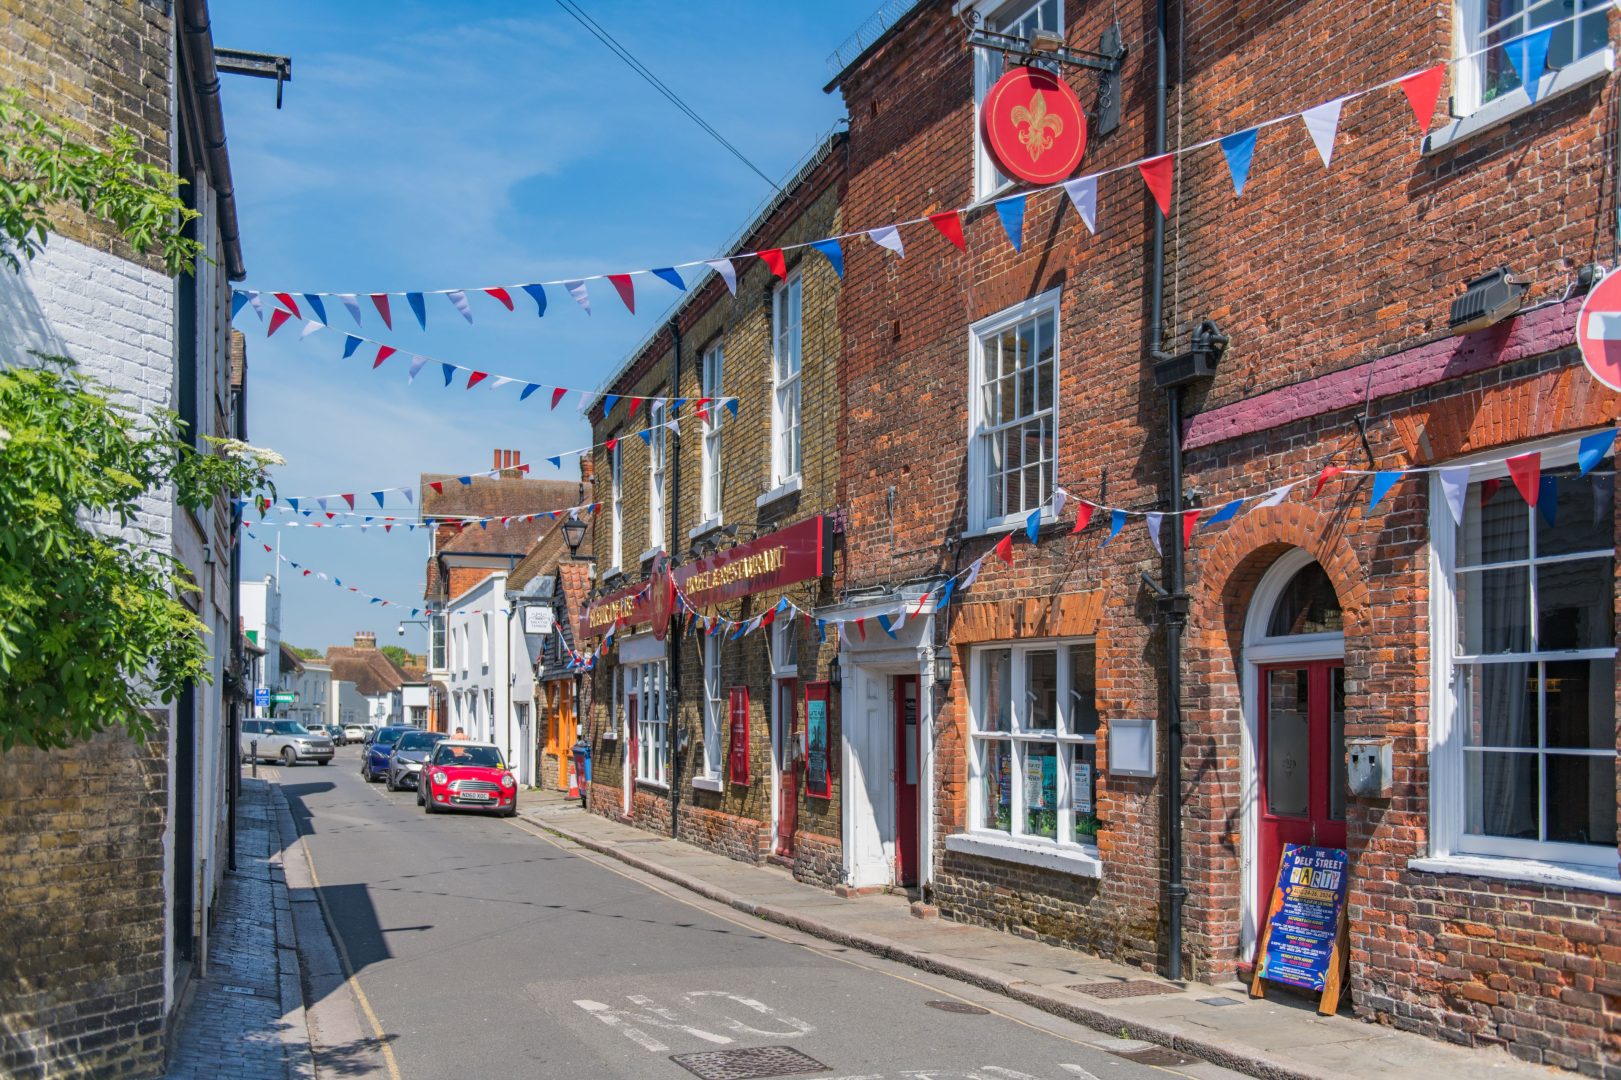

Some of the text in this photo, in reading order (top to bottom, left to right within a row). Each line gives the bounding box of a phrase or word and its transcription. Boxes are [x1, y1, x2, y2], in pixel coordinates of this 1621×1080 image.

[721, 545, 787, 585] RESTAURANT
[1294, 855, 1344, 870] DELF STREET
[1315, 850, 1326, 858] THE
[1291, 867, 1341, 889] PARTY
